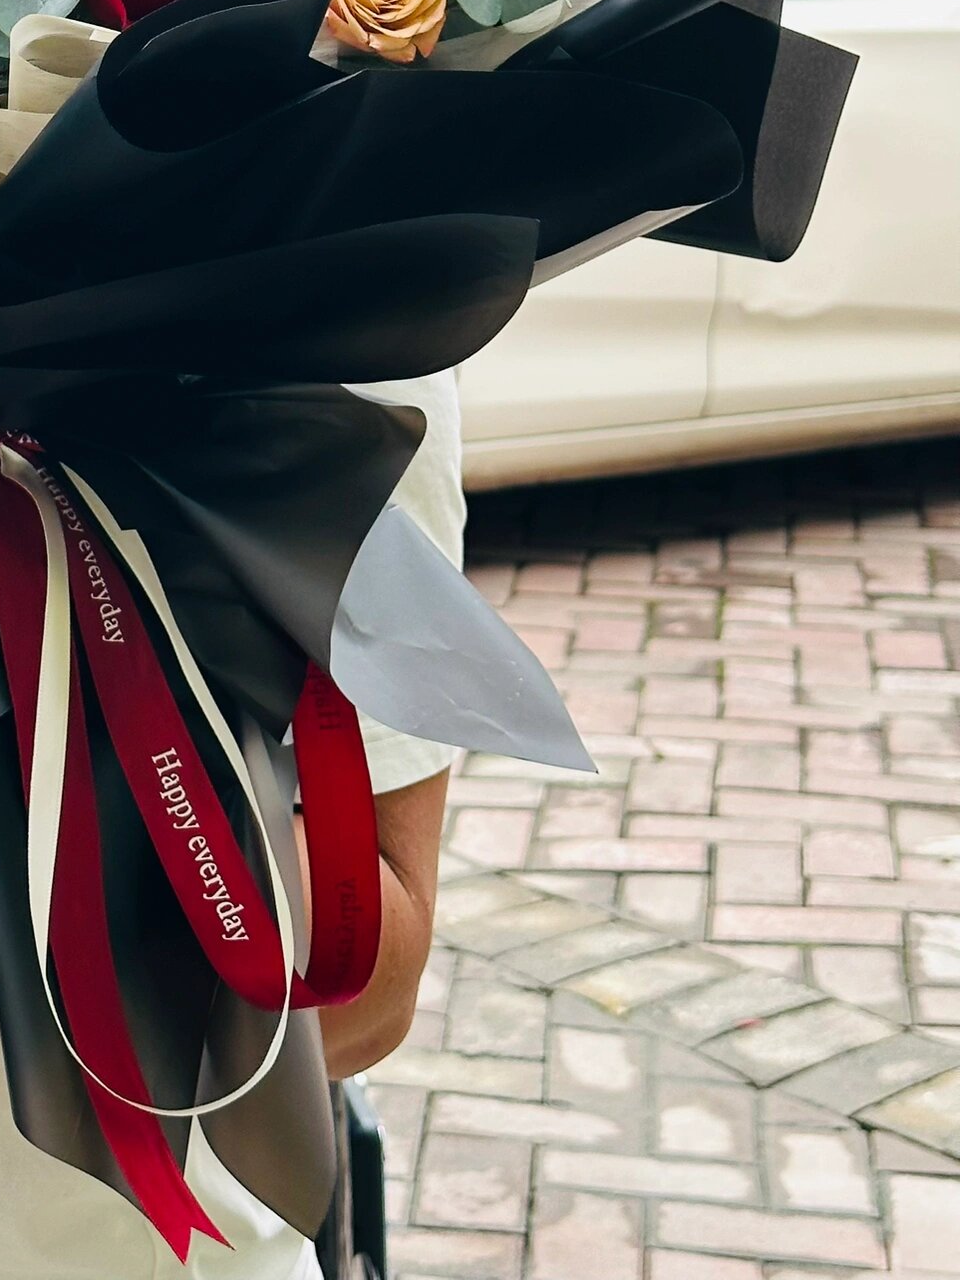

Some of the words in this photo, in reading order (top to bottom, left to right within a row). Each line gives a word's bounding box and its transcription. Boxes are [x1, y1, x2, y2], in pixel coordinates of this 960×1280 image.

[78, 538, 125, 645] everyday
[151, 747, 201, 832] Happy
[187, 834, 250, 945] everyday
